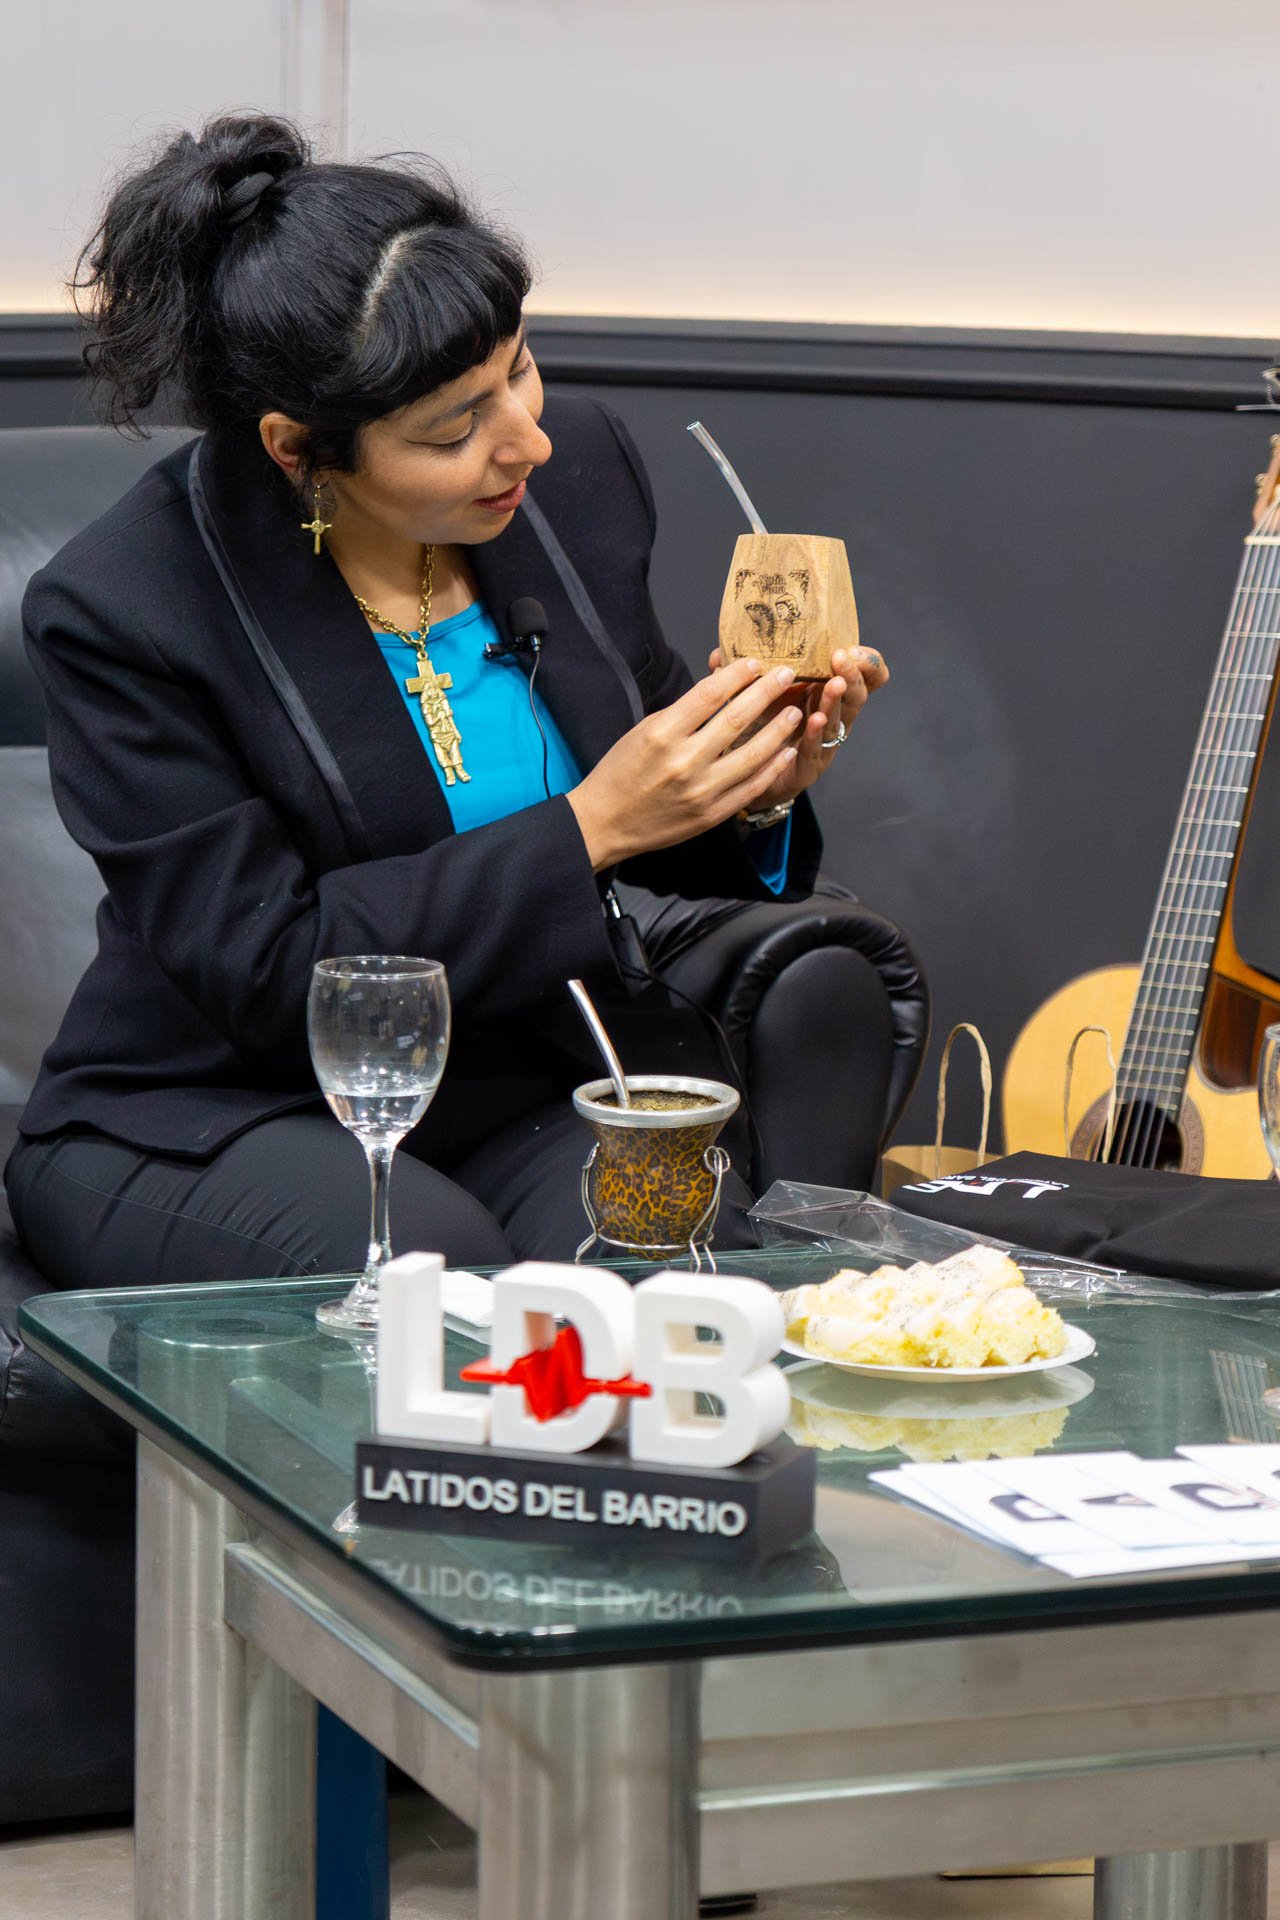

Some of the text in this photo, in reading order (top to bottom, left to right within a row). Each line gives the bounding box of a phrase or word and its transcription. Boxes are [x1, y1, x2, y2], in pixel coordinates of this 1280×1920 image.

[377, 1251, 790, 1468] LDB
[362, 1466, 748, 1537] LATIDOS DEL BARRIO
